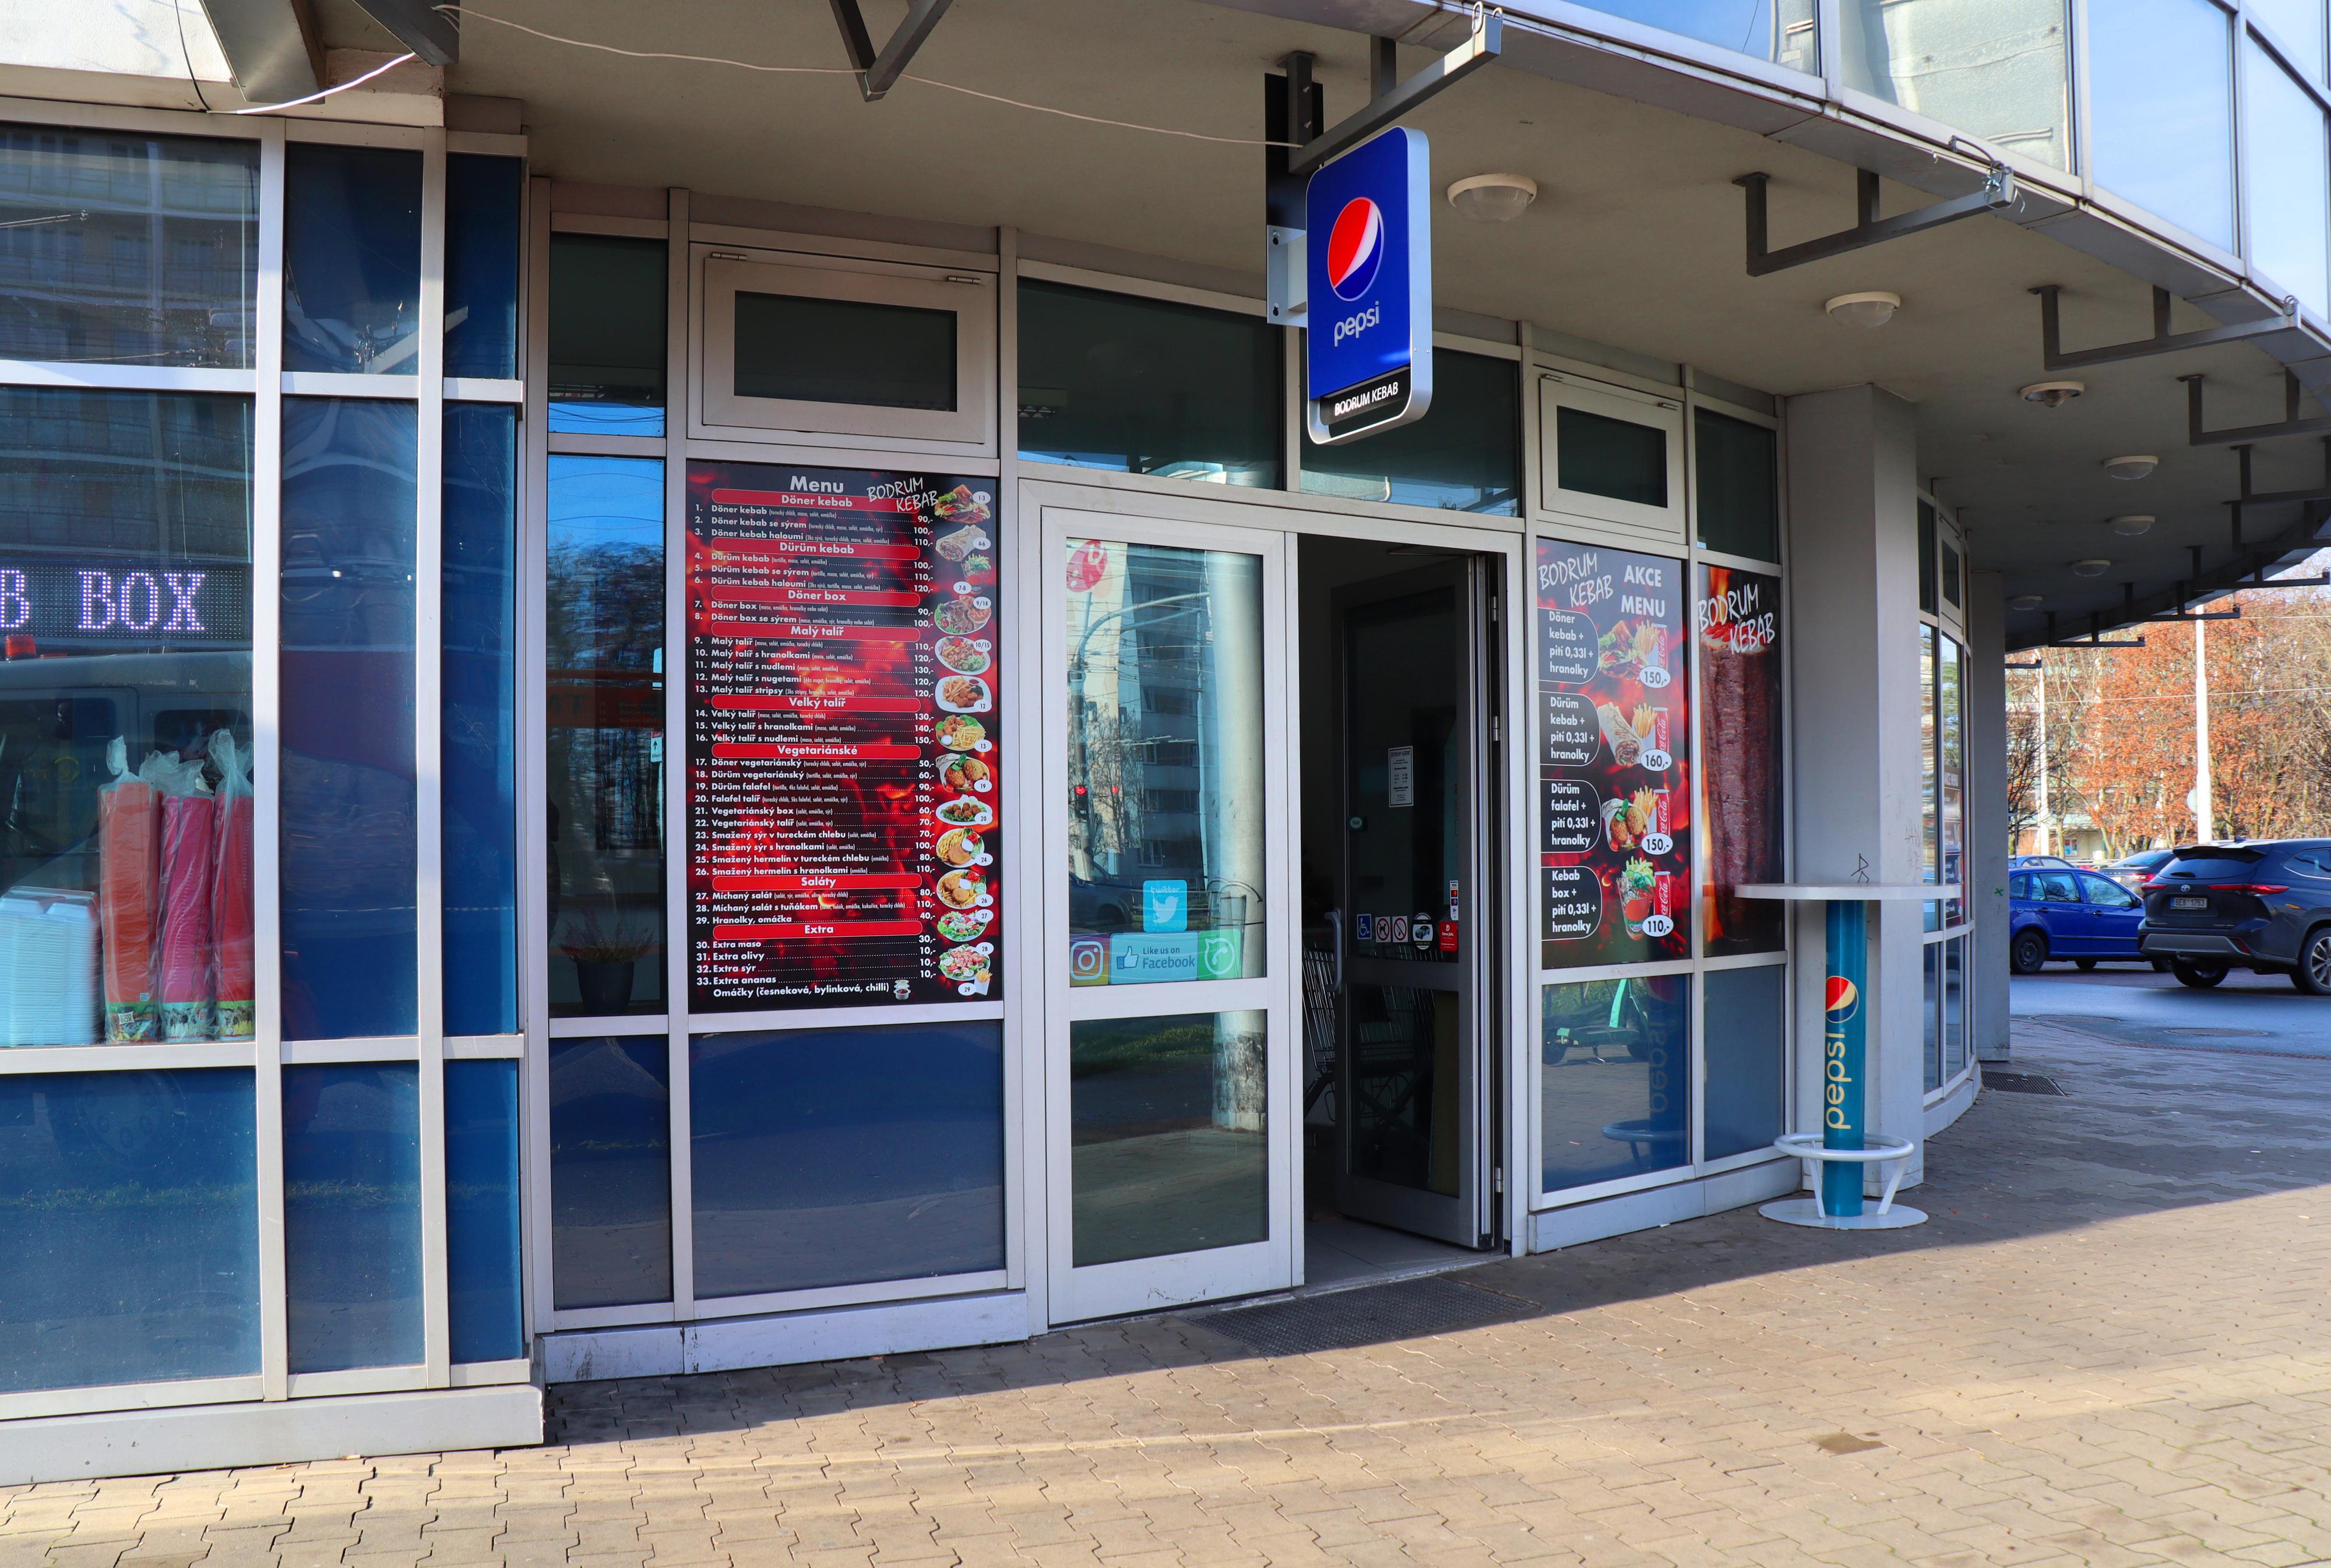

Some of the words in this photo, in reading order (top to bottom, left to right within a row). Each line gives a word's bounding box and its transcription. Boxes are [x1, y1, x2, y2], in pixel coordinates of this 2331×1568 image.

[1333, 301, 1380, 347] pepsi
[1334, 392, 1371, 417] BODRUM
[1371, 381, 1399, 403] KEBAB
[790, 475, 844, 493] Menu
[867, 477, 924, 502] BODRUM
[781, 495, 815, 505] Döner
[818, 496, 853, 507] kebab
[896, 491, 938, 512] KEBAB
[711, 505, 738, 514] Döner
[740, 507, 767, 515] kebab
[917, 515, 933, 524] 90,-
[780, 542, 816, 552] Dürüm
[819, 543, 854, 554] kebab
[1538, 552, 1597, 590] BODRUM
[1624, 565, 1661, 587] AKCE
[788, 590, 822, 600] Döner
[824, 590, 846, 601] box
[1569, 575, 1613, 608] KEBAB
[77, 571, 206, 631] BOX
[711, 601, 738, 609] Döner
[918, 608, 934, 616] 90,-
[1621, 595, 1665, 618] MENU
[1698, 584, 1759, 632] BODRUM
[1549, 611, 1575, 623] Döner
[790, 625, 819, 638] Malý
[821, 626, 844, 636] talíř
[1549, 628, 1576, 641] kebab
[1578, 632, 1584, 640] +
[1730, 612, 1776, 655] KEBAB
[695, 649, 707, 657] 10.
[711, 649, 733, 660] Malý
[735, 650, 753, 658] talíř
[760, 651, 810, 660] hranolkami
[914, 654, 934, 664] 120,-
[1550, 645, 1564, 658] pití
[1565, 646, 1586, 659] 0,33l
[1550, 661, 1589, 679] hranolky
[1644, 671, 1667, 686] 150,-
[789, 697, 821, 710] Velký
[824, 698, 846, 708] talíř
[1550, 696, 1579, 709] Dürüm
[1550, 713, 1578, 725] kebab
[1580, 717, 1585, 725] +
[1551, 730, 1565, 745] pití
[1566, 731, 1587, 744] 0,33l
[777, 745, 858, 757] Vegetariánské
[1551, 748, 1590, 763] hranolky
[696, 759, 707, 767] 17.
[712, 757, 738, 767] Döner
[741, 759, 801, 769] vegetariánský
[918, 760, 934, 769] 50,-
[1645, 754, 1668, 770] 160,-
[1551, 783, 1580, 794] Dürüm
[1551, 799, 1579, 811] falafel
[1580, 802, 1586, 810] +
[1551, 816, 1566, 831] pití
[1566, 816, 1589, 830] 0,33l
[1590, 819, 1596, 827] +
[1551, 833, 1591, 848] hranolky
[1646, 838, 1670, 853] 150,-
[696, 855, 709, 864] 25.
[712, 854, 752, 865] Smažený
[754, 854, 791, 863] hermelín
[801, 854, 840, 862] tureckém
[842, 854, 869, 862] chlebu
[871, 855, 889, 863] (omáčka)
[920, 853, 935, 862] 80,-
[801, 876, 836, 889] Saláty
[1552, 869, 1580, 881] Kebab
[1552, 886, 1570, 898] box
[1571, 888, 1577, 896] +
[1552, 904, 1566, 918] pití
[1568, 902, 1589, 916] 0,33l
[696, 916, 710, 924] 29.
[713, 915, 755, 926] Hranolky,
[758, 914, 792, 924] omáčka
[920, 912, 935, 921] 40,-
[1552, 919, 1591, 934] hranolky
[1647, 919, 1670, 934] 110,-
[804, 925, 834, 934] Extra
[1142, 955, 1195, 969] Facebook
[696, 977, 712, 985] 33.
[713, 977, 738, 985] Extra
[741, 977, 777, 985] ananas
[920, 970, 936, 979] 10,-
[713, 986, 754, 999] Omáčky
[756, 985, 812, 997] (česneková,
[815, 984, 863, 996] bylinková,
[865, 982, 889, 993] chilli)
[1826, 1031, 1852, 1130] pepsi
